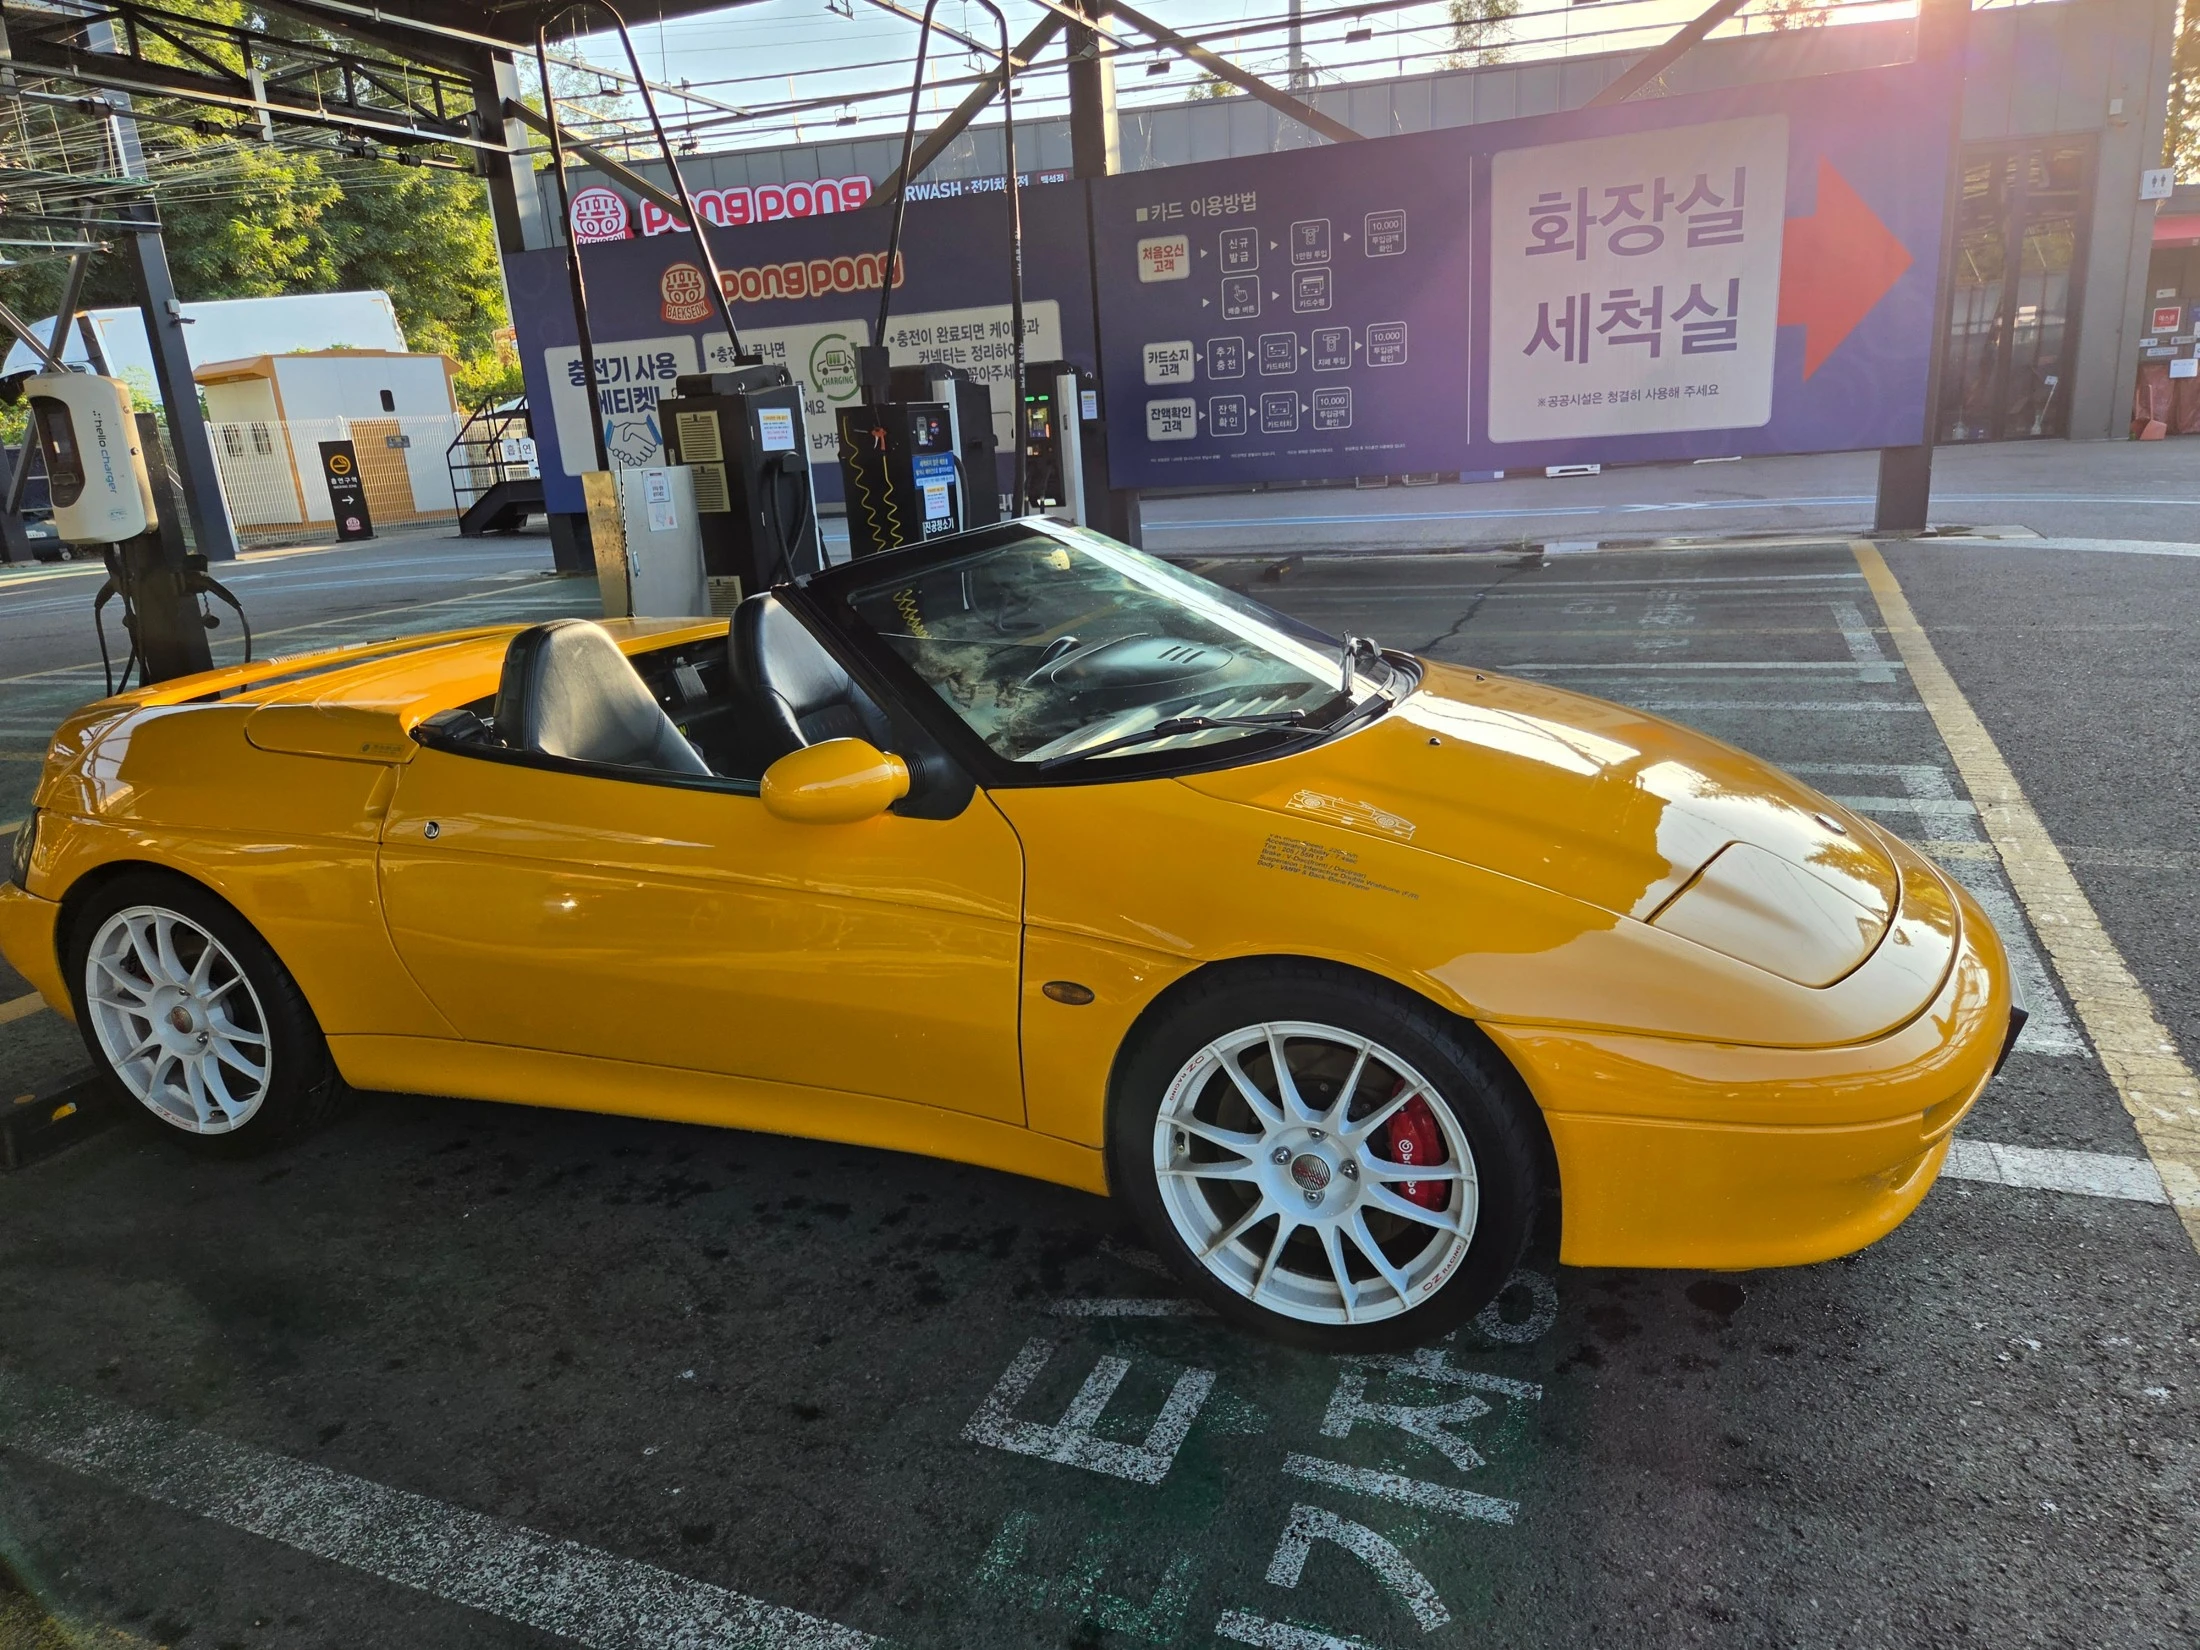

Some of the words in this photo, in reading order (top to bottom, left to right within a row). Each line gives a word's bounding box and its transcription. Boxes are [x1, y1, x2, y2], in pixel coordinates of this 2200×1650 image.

[970, 174, 1029, 193] 전기차전
[758, 179, 870, 222] pong
[1151, 202, 1184, 221] 카드
[1190, 191, 1257, 217] 이용방법
[1525, 166, 1746, 261] 화장실
[1373, 220, 1399, 231] 10,000
[1142, 243, 1184, 261] 처음오신
[1153, 259, 1175, 273] 고객
[667, 302, 707, 319] BAEKSEOK
[1522, 277, 1740, 364] 세척실
[896, 327, 932, 348] 충전이
[936, 322, 985, 344] 완료되면
[1374, 331, 1400, 342] 10,000
[752, 341, 786, 361] 끝나면
[918, 345, 967, 364] 커넥터는
[1148, 349, 1189, 364] 카드소지
[567, 356, 631, 387] 충전기
[635, 352, 678, 381] 사용
[967, 363, 1016, 384] 꽂아주세
[1159, 363, 1180, 376] 고객
[821, 375, 854, 387] CHARGING
[1320, 396, 1346, 407] 10,000
[1607, 389, 1641, 404] 청결히
[1645, 386, 1680, 401] 사용해
[1684, 383, 1720, 398] 주세요
[804, 399, 827, 415] 세요
[1151, 406, 1192, 421] 잔액확인
[1161, 420, 1182, 433] 고객
[94, 419, 107, 448] hello
[101, 449, 118, 494] charger
[924, 517, 955, 535] 진공청소기
